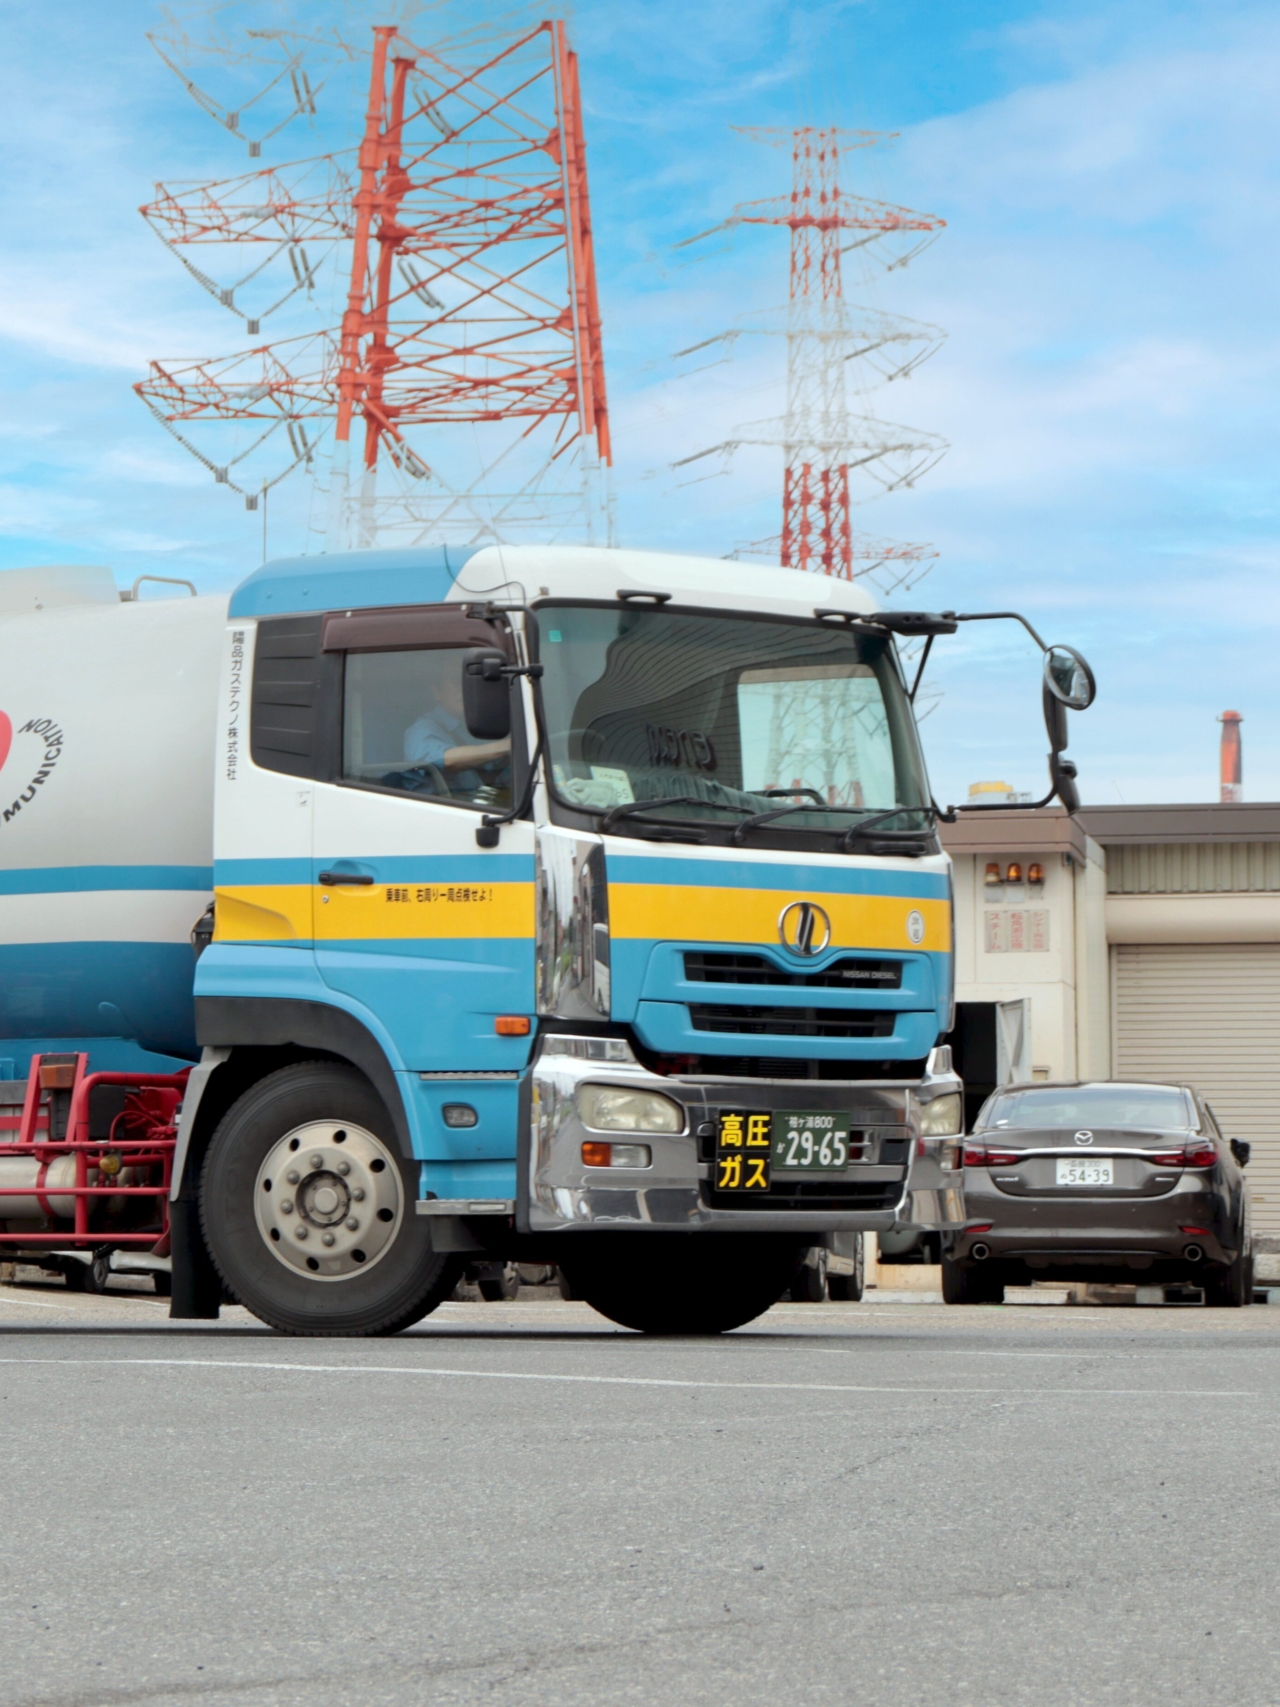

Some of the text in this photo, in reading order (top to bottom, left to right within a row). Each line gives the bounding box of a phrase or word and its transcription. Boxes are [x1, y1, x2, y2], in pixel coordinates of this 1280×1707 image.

[991, 912, 1003, 951] スチーム
[720, 1113, 771, 1147] 高圧
[785, 1130, 847, 1166] 29-65
[719, 1154, 768, 1188] ガス
[1069, 1169, 1110, 1183] 54-39
